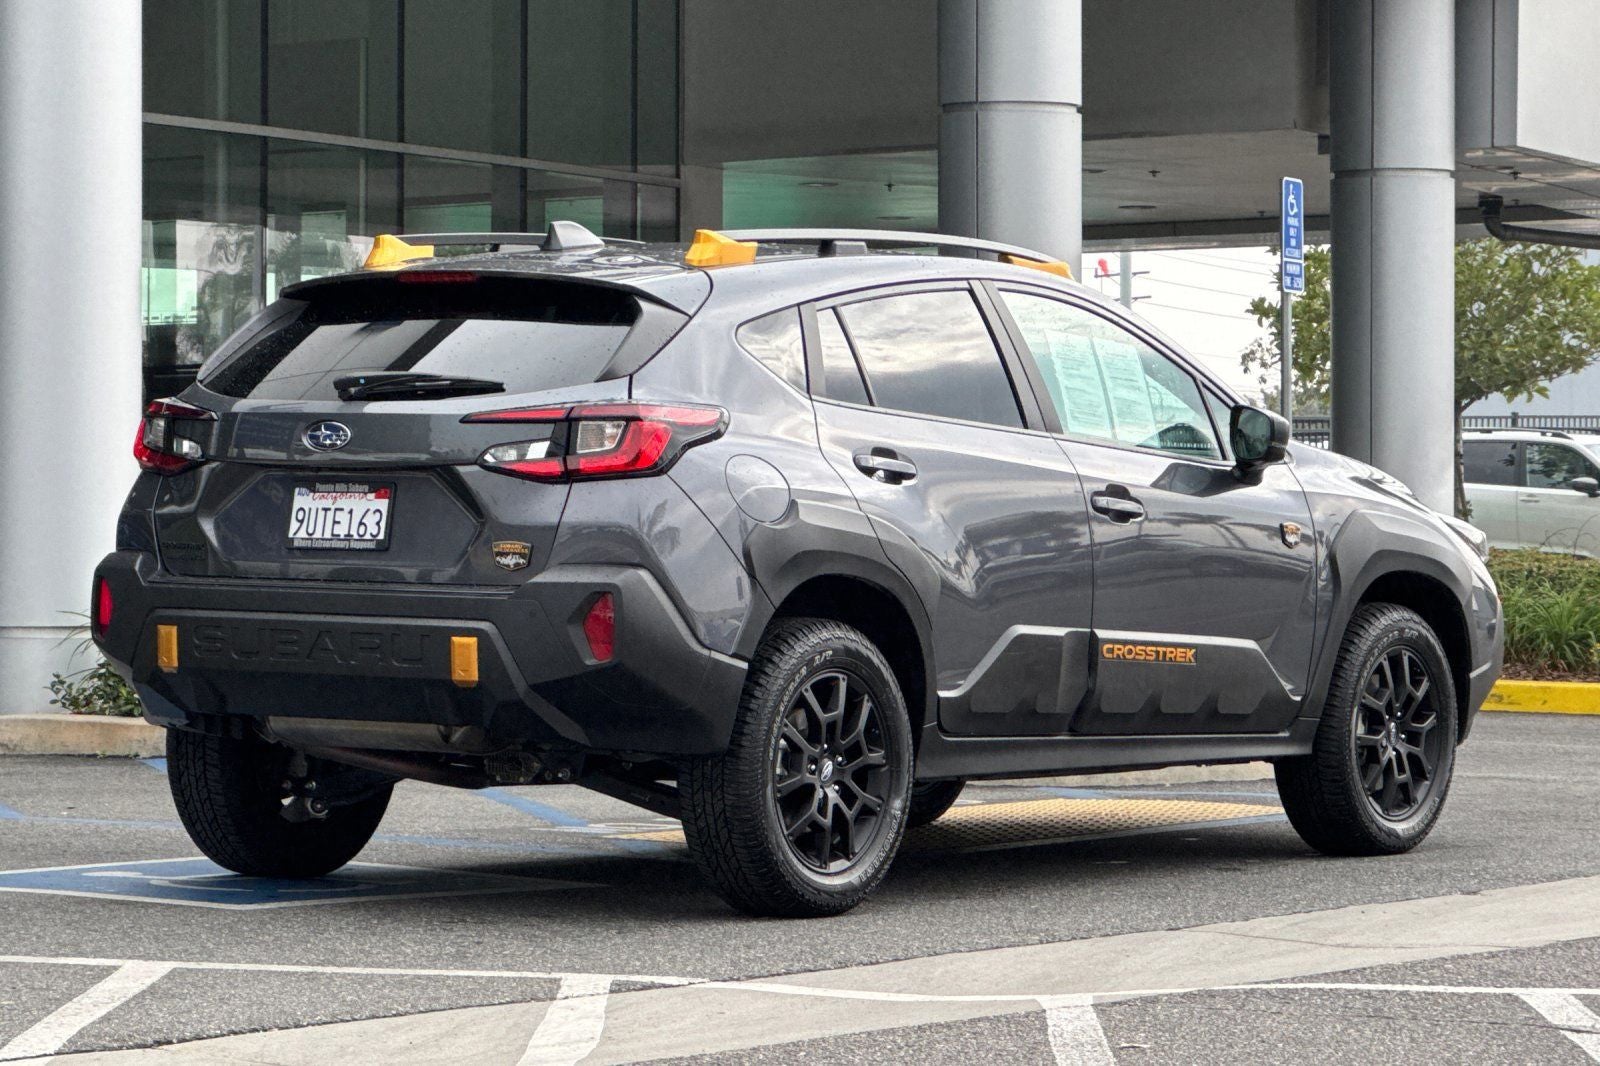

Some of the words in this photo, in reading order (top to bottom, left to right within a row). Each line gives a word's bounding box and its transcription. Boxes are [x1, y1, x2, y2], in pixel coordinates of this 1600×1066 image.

[335, 482, 348, 493] Hills
[348, 482, 369, 493] Subaru
[292, 506, 384, 539] 9UTE163
[293, 539, 312, 549] Where
[312, 539, 350, 550] Extraordinary
[192, 624, 431, 668] SUBARU
[1102, 643, 1197, 663] CROSSTREK
